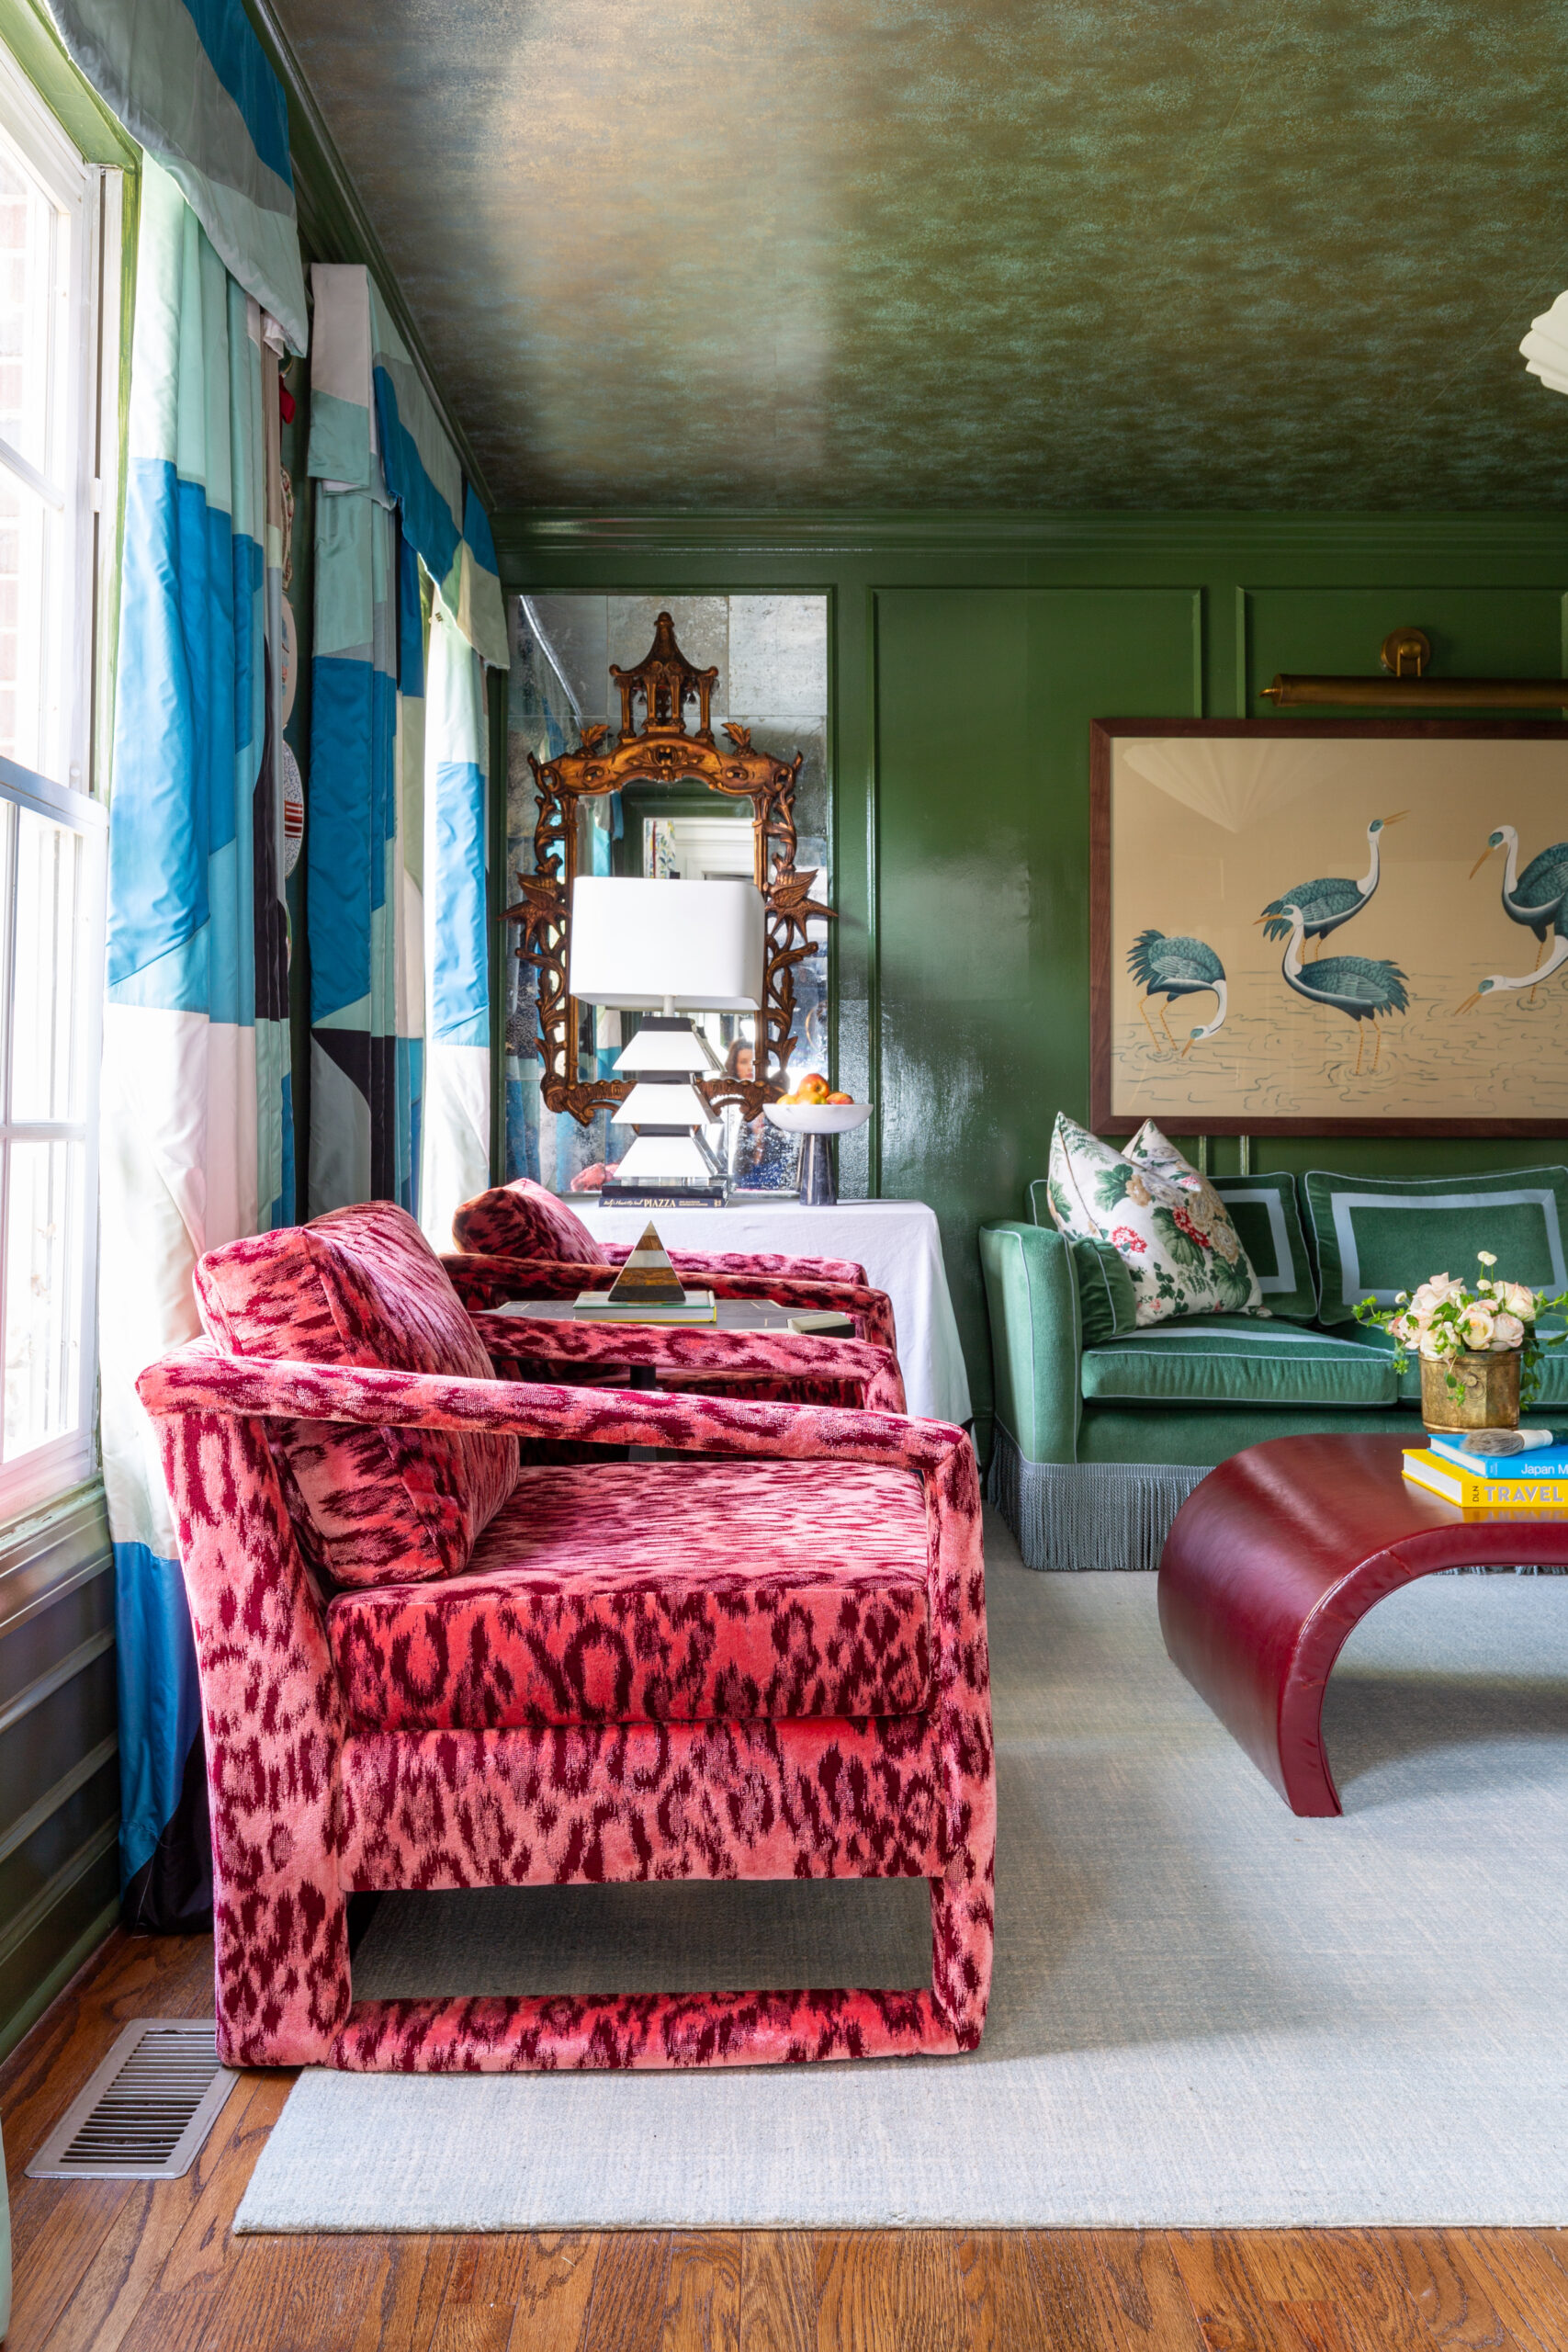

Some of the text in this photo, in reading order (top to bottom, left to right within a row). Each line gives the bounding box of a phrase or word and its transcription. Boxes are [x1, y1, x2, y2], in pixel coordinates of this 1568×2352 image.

[644, 1198, 676, 1208] PIAZZA
[1521, 1464, 1555, 1476] Japan
[1483, 1486, 1564, 1502] TRAVEL
